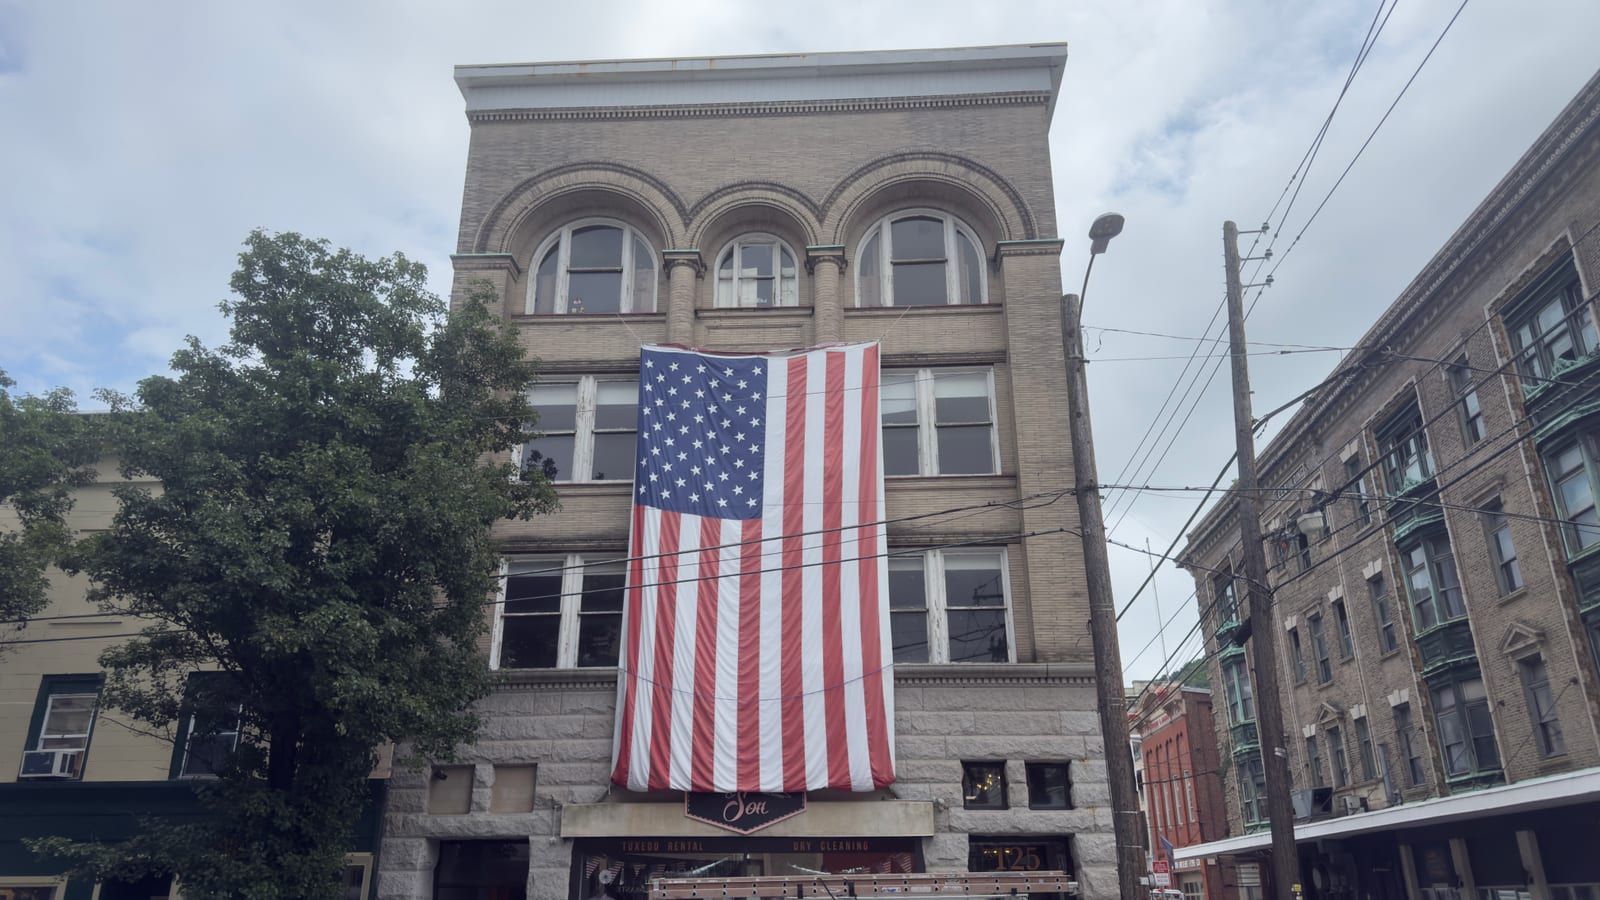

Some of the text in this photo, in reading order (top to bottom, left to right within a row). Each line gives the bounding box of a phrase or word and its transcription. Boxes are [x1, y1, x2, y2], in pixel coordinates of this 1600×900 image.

[722, 791, 769, 823] Son
[622, 841, 705, 852] TUXEDO RENTAL
[793, 841, 869, 851] DRY CLEANING
[995, 846, 1041, 871] 125
